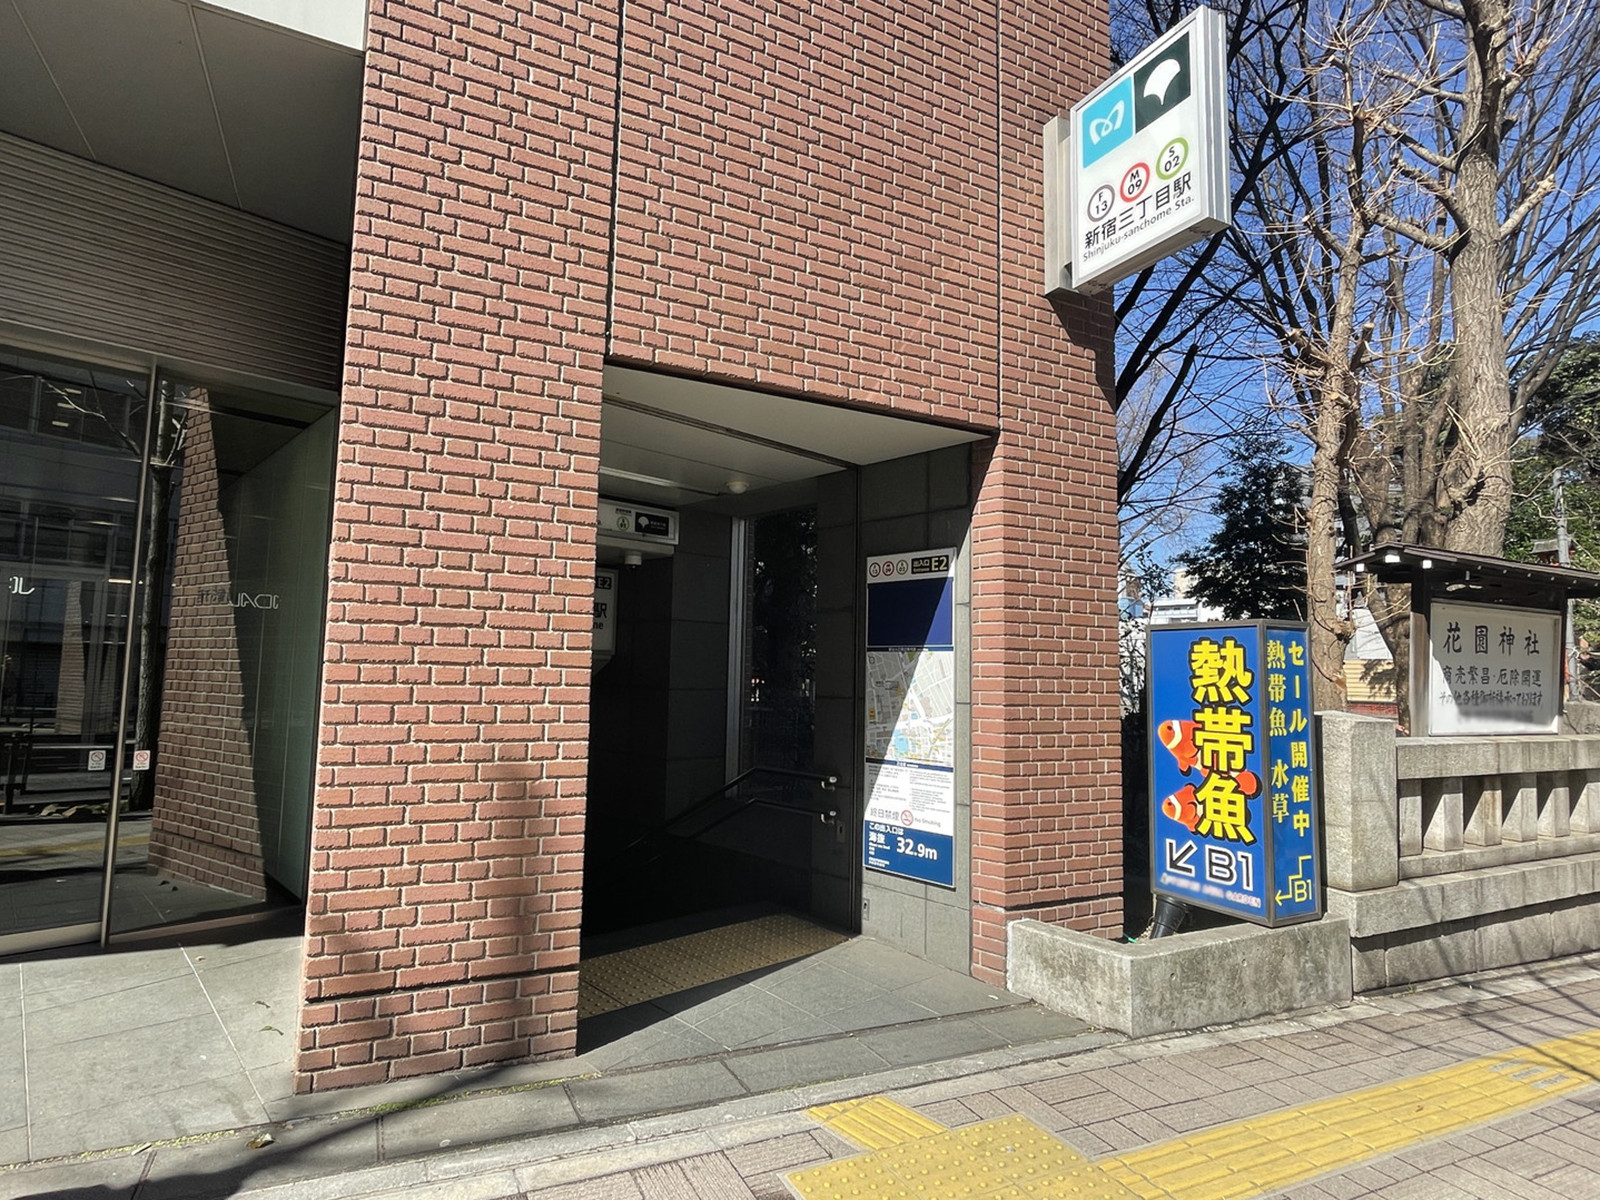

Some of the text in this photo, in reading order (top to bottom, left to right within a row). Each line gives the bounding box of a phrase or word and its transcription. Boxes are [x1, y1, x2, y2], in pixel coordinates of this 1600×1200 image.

[1164, 155, 1181, 173] 02
[1168, 146, 1176, 158] S
[1127, 178, 1142, 196] 09
[1129, 168, 1140, 182] M
[1095, 201, 1108, 214] 13
[1098, 192, 1104, 202] F
[1085, 171, 1192, 249] 新宿三丁目駅
[1083, 195, 1194, 262] Shinjuku-sanchome Sta.
[931, 556, 948, 571] E2
[1443, 621, 1540, 656] 花園神社
[1190, 638, 1255, 845] 熱帯魚
[1267, 640, 1290, 823] 熱帯魚 水草
[1288, 641, 1311, 837] セール開催中
[896, 836, 938, 861] 32.9m
[1205, 844, 1254, 891] B1
[1294, 879, 1312, 902] B1
